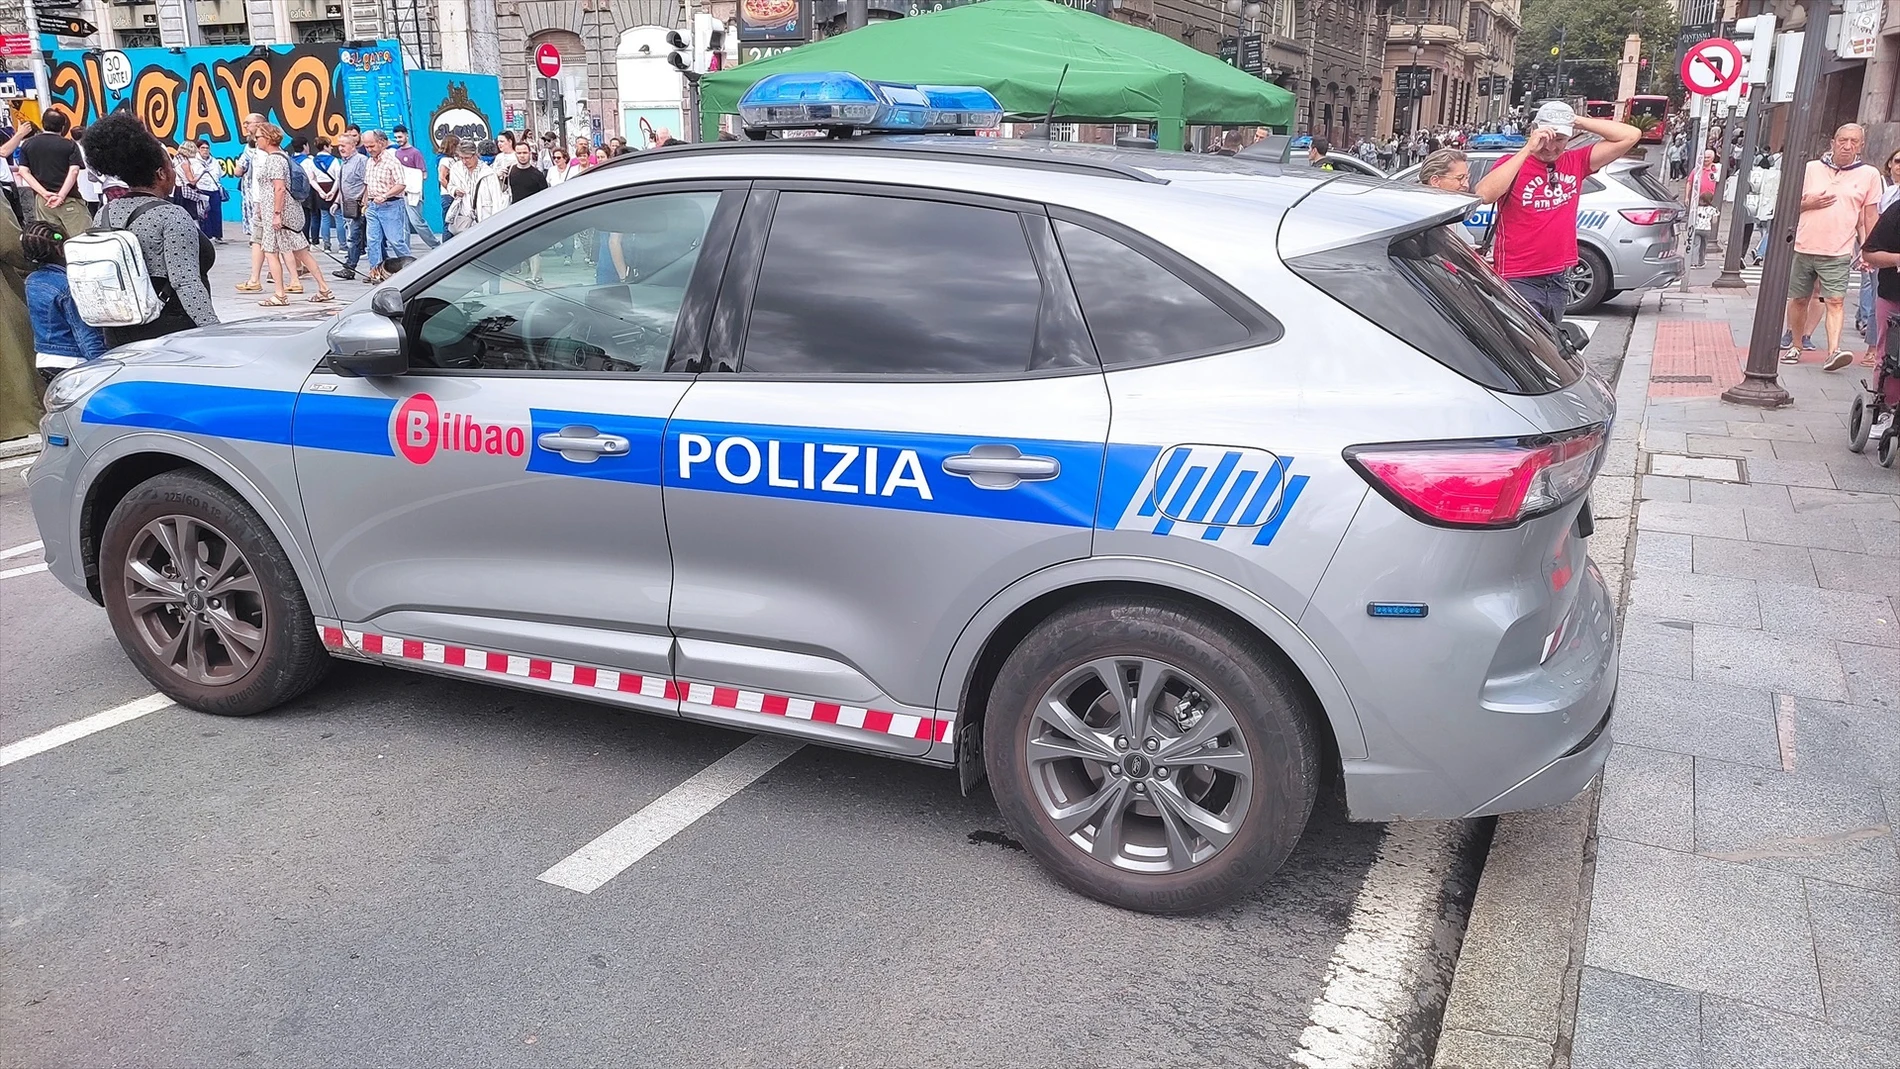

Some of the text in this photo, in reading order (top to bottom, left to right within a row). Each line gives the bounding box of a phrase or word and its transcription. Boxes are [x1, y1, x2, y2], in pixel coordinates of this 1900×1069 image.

[105, 56, 120, 71] 30
[107, 71, 128, 84] URTE!
[1522, 176, 1544, 207] TOKYO
[407, 411, 525, 458] Bilbao
[678, 433, 934, 501] POLIZIA
